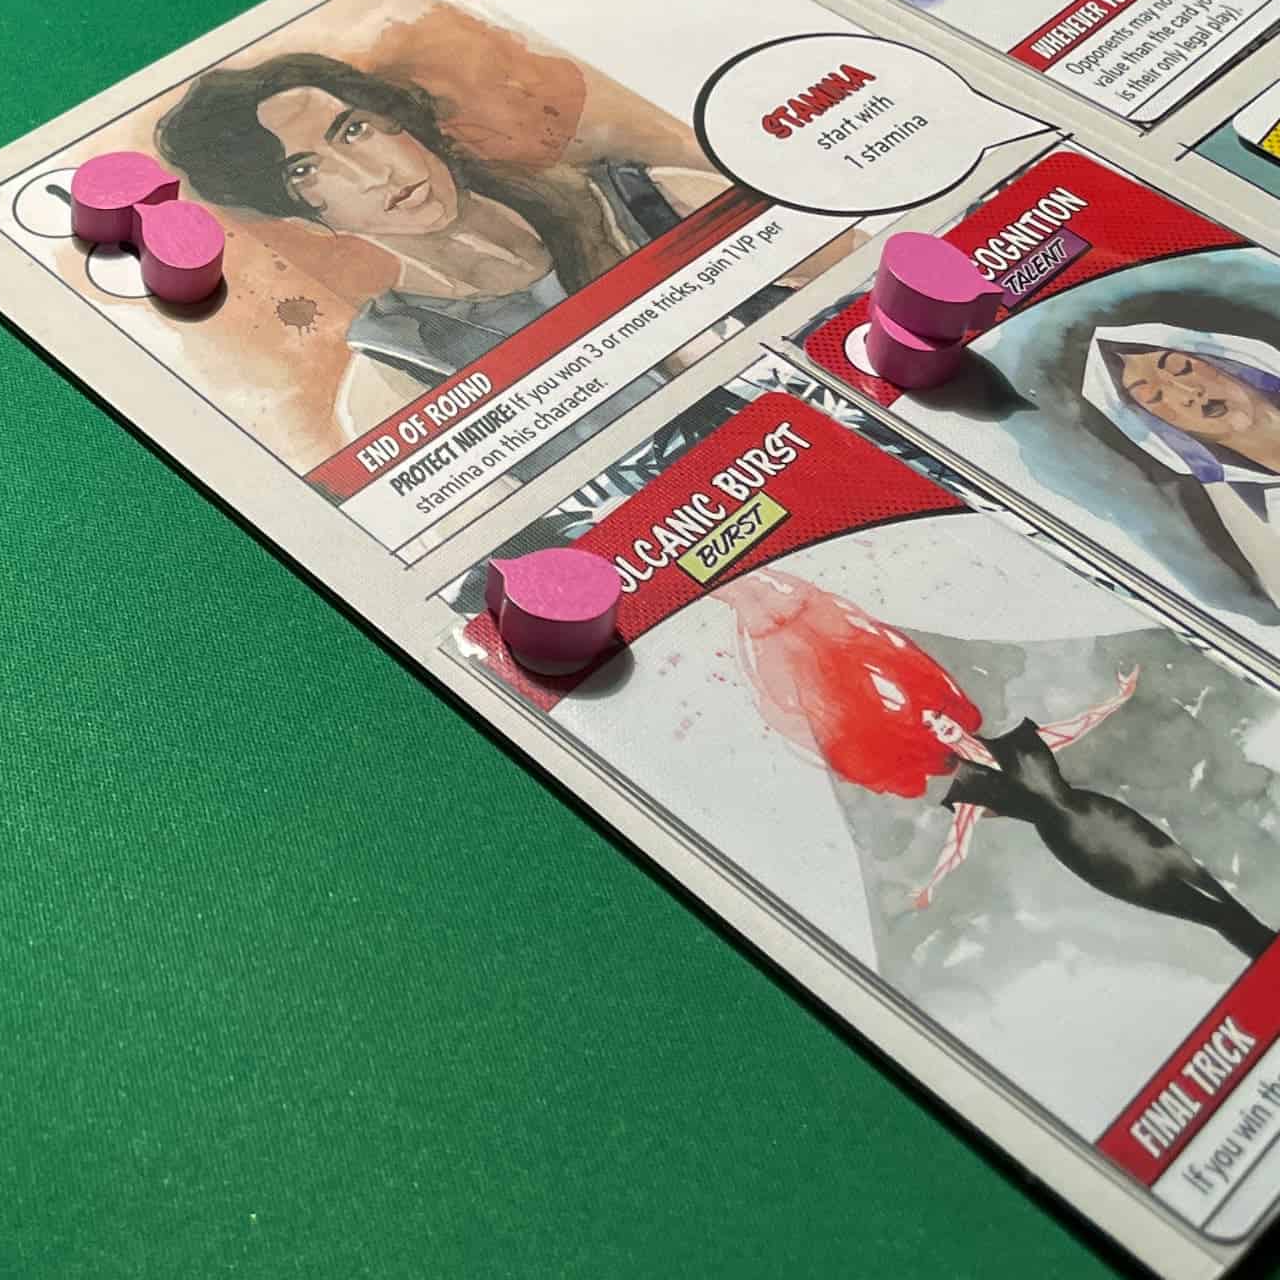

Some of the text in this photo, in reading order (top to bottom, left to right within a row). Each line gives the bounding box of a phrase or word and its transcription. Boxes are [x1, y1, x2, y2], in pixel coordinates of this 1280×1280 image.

[1031, 1, 1109, 60] WHENEVER
[1065, 27, 1134, 75] Opponents
[1129, 8, 1160, 30] may
[1094, 62, 1130, 87] value
[1122, 41, 1157, 64] than
[1148, 26, 1175, 43] the
[1171, 4, 1199, 28] card
[1114, 4, 1243, 102] is their only legal play).
[762, 64, 876, 139] STAMINA
[817, 95, 895, 150] start with
[844, 115, 928, 169] 1 stamina
[1001, 236, 1067, 295] TALENT
[389, 440, 458, 496] PROTECT
[511, 392, 531, 411] If
[528, 376, 560, 404] you
[555, 353, 592, 381] won
[583, 343, 604, 359] 3
[601, 332, 621, 350] or
[618, 306, 659, 338] more
[652, 281, 703, 317] tricks,
[697, 257, 733, 286] gain
[757, 221, 784, 244] per
[356, 372, 492, 473] END OF ROUND
[415, 377, 609, 514] stamina on this character.
[712, 422, 811, 501] BURST
[696, 502, 761, 568] BURST
[1130, 1016, 1256, 1159] FINAL TRICK
[1182, 1164, 1213, 1195] If
[1205, 1137, 1244, 1183] you
[1233, 1104, 1272, 1140] win
